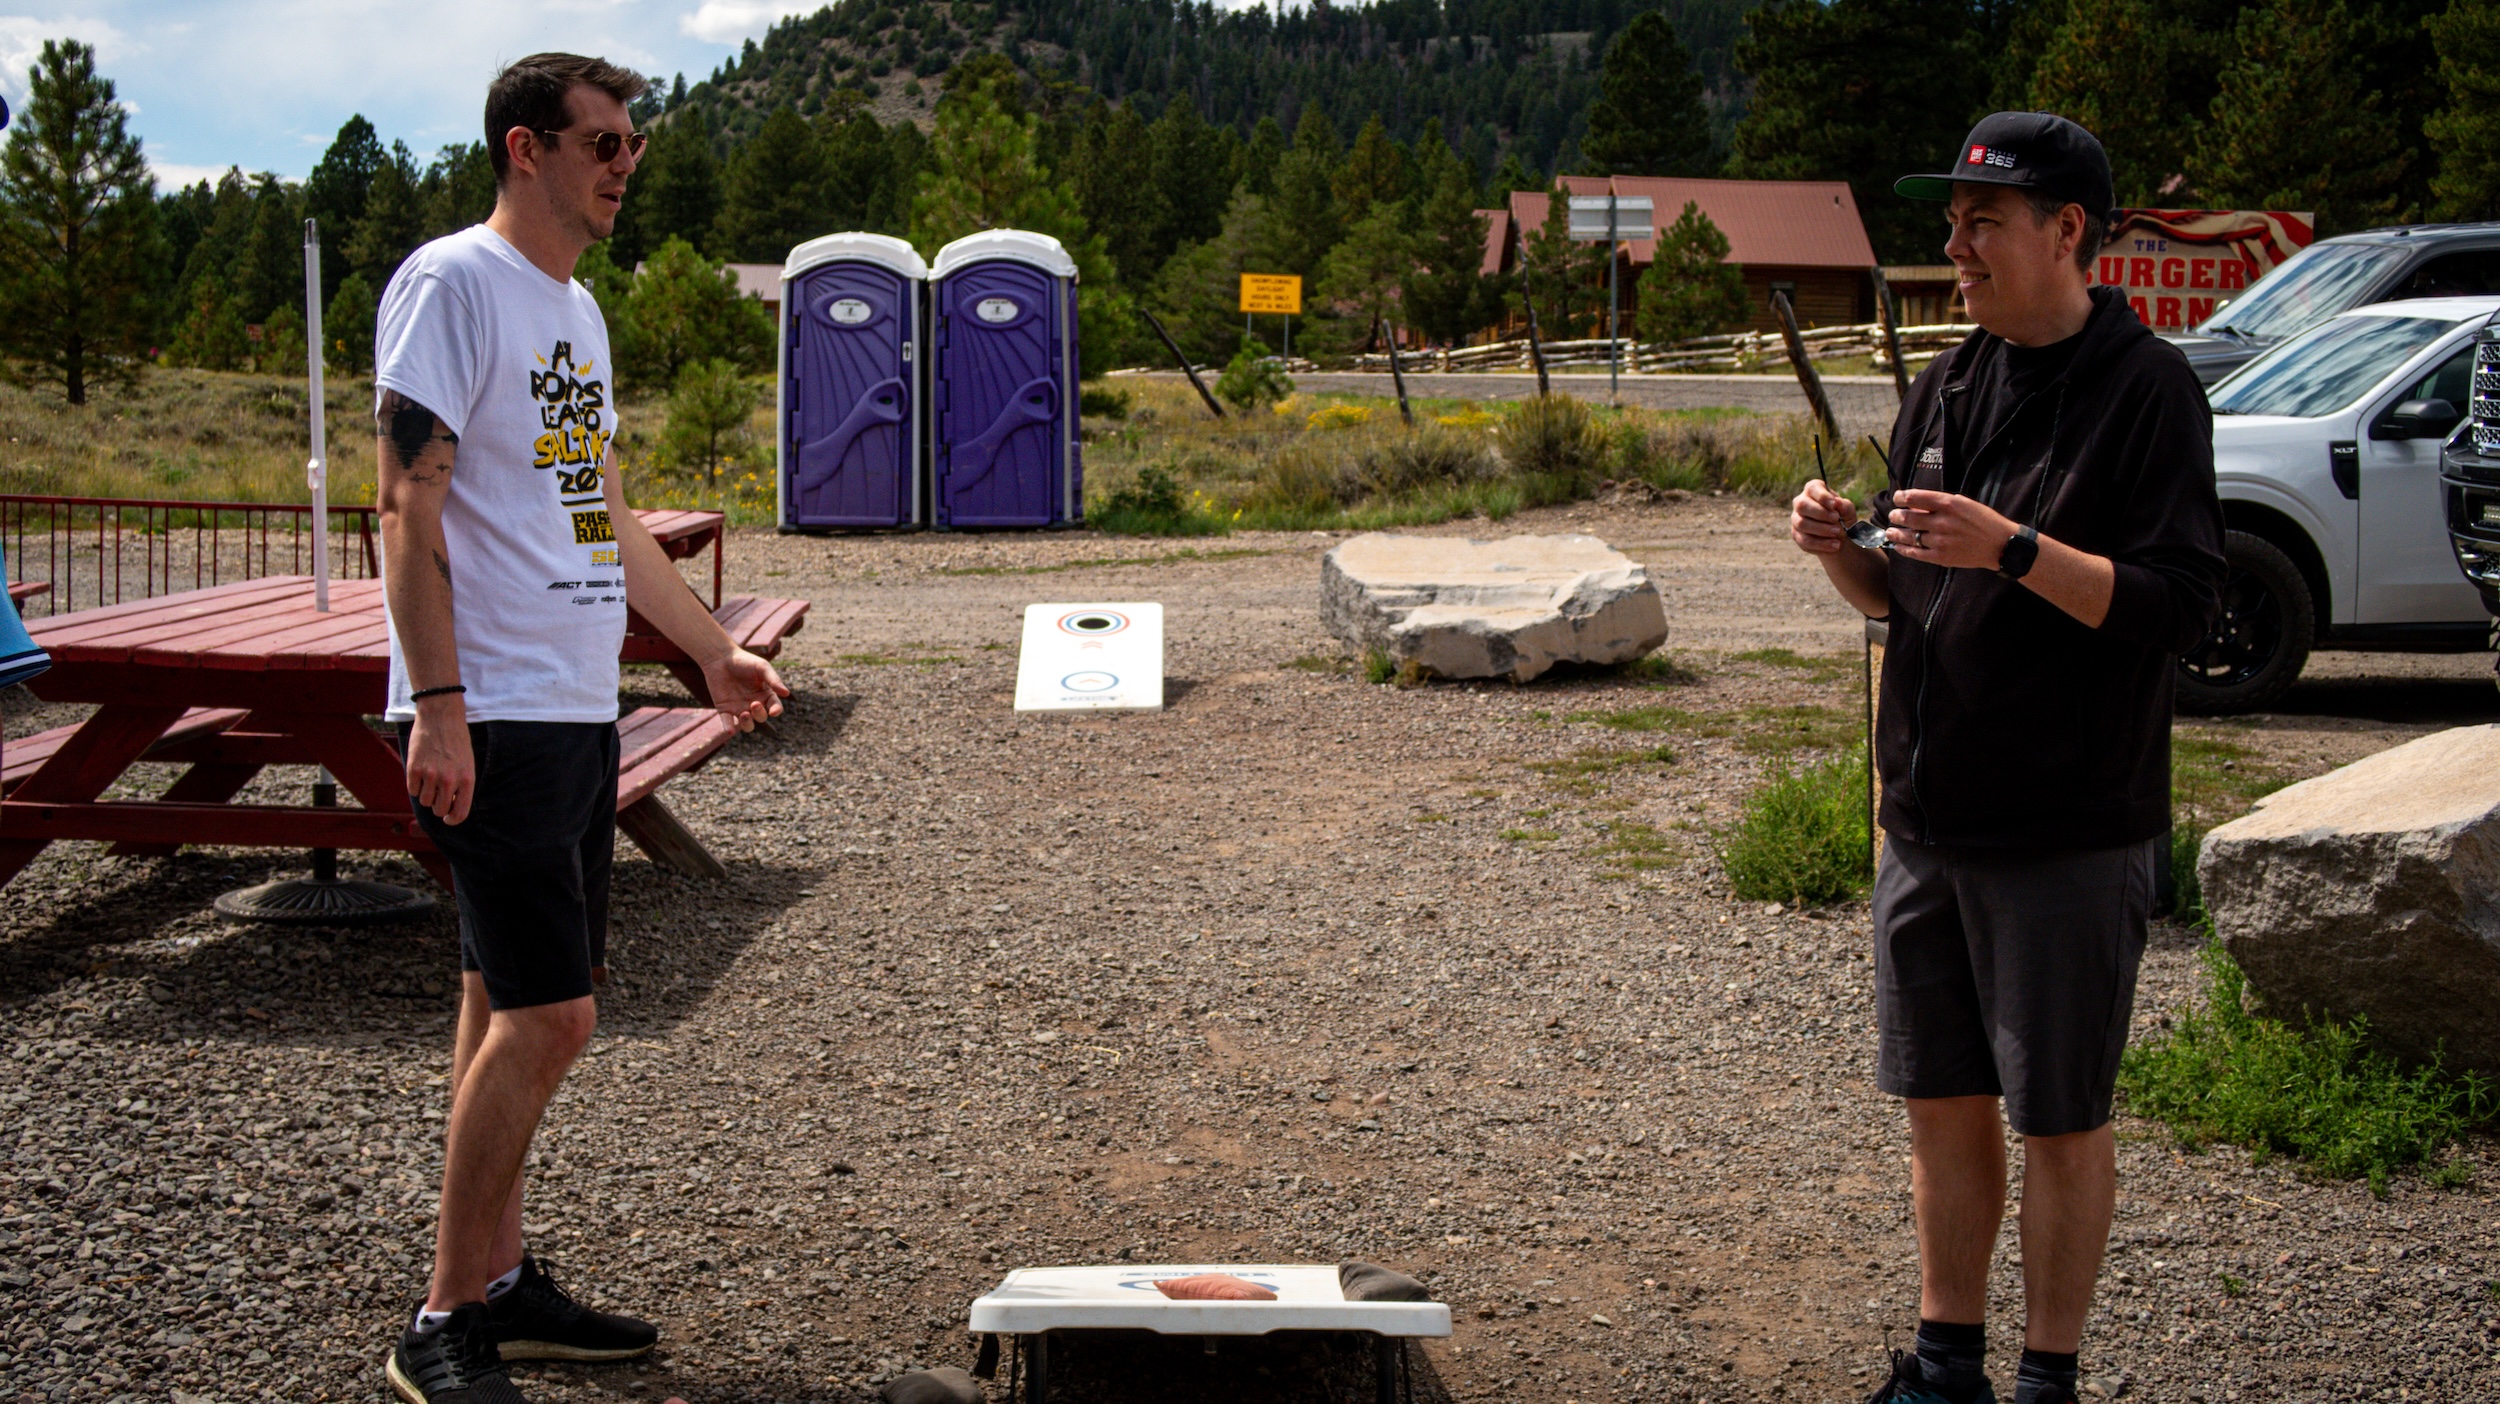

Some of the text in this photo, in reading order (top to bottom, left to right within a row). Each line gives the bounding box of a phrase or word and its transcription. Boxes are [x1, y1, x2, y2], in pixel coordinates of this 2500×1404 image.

[1985, 153, 2015, 168] 365
[2134, 239, 2167, 252] THE
[2087, 256, 2246, 289] URGER
